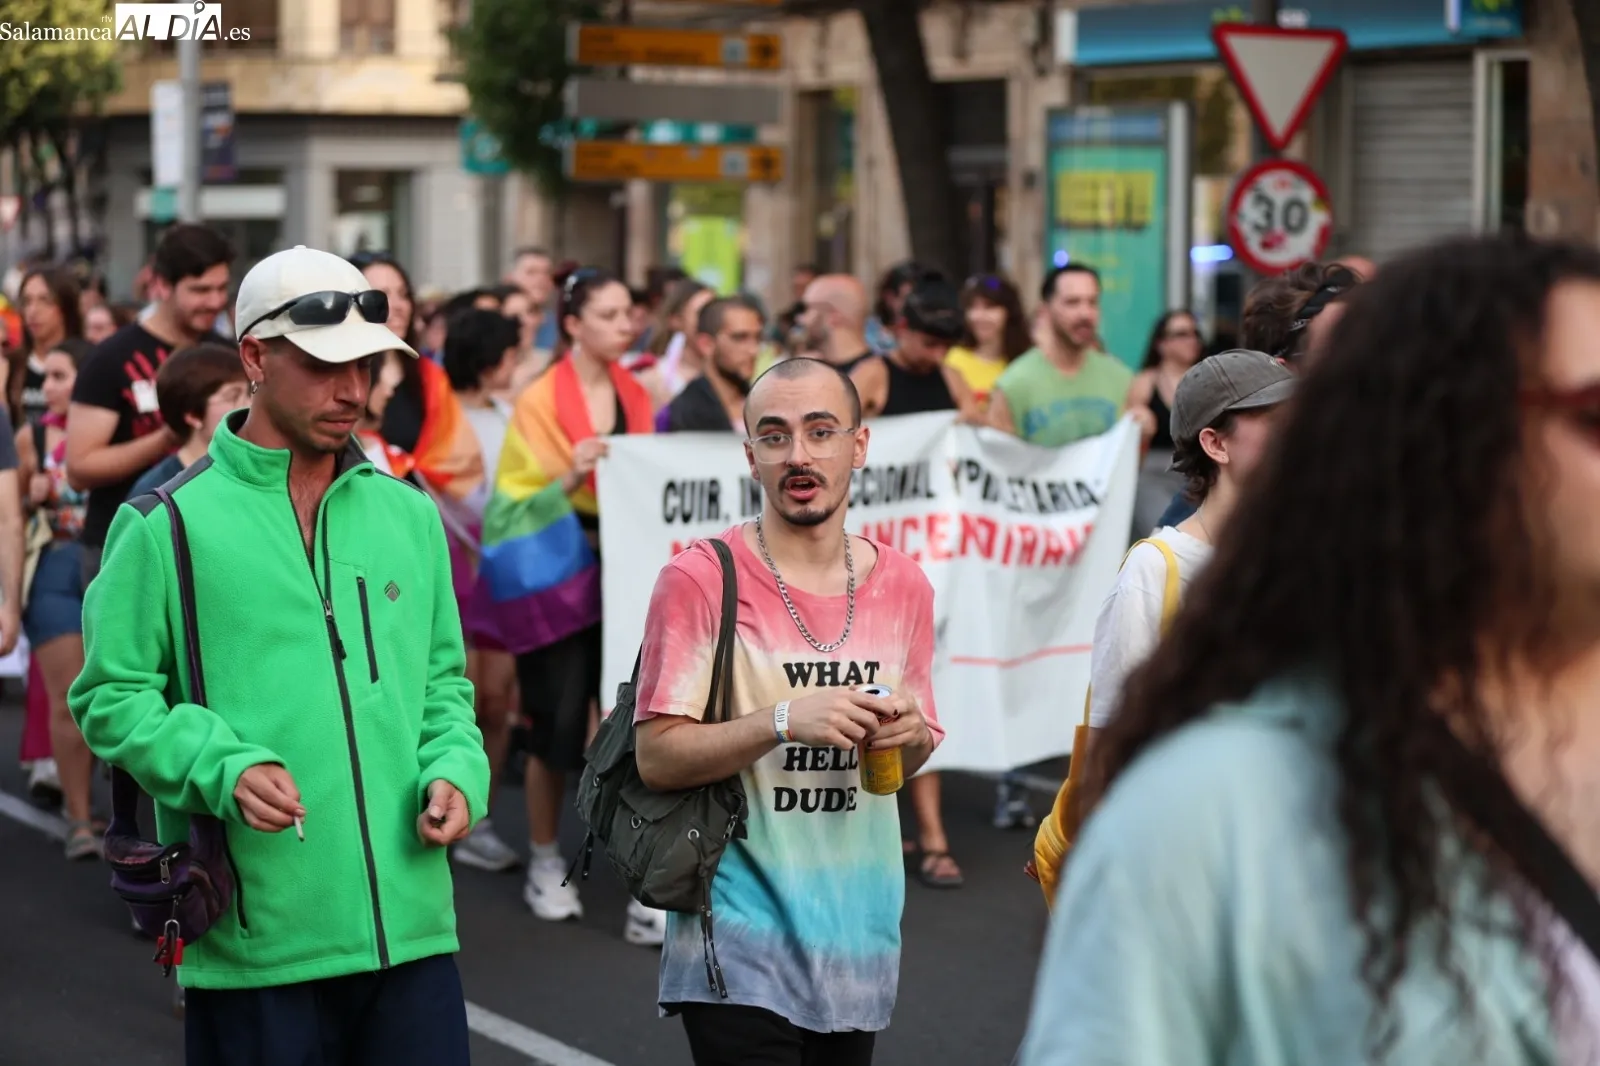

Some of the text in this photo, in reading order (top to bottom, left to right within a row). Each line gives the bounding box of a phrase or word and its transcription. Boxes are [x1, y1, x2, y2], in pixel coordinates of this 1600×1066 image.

[1252, 190, 1309, 237] 30
[782, 660, 880, 688] WHAT
[782, 745, 859, 772] HELL
[772, 785, 858, 814] DUDE
